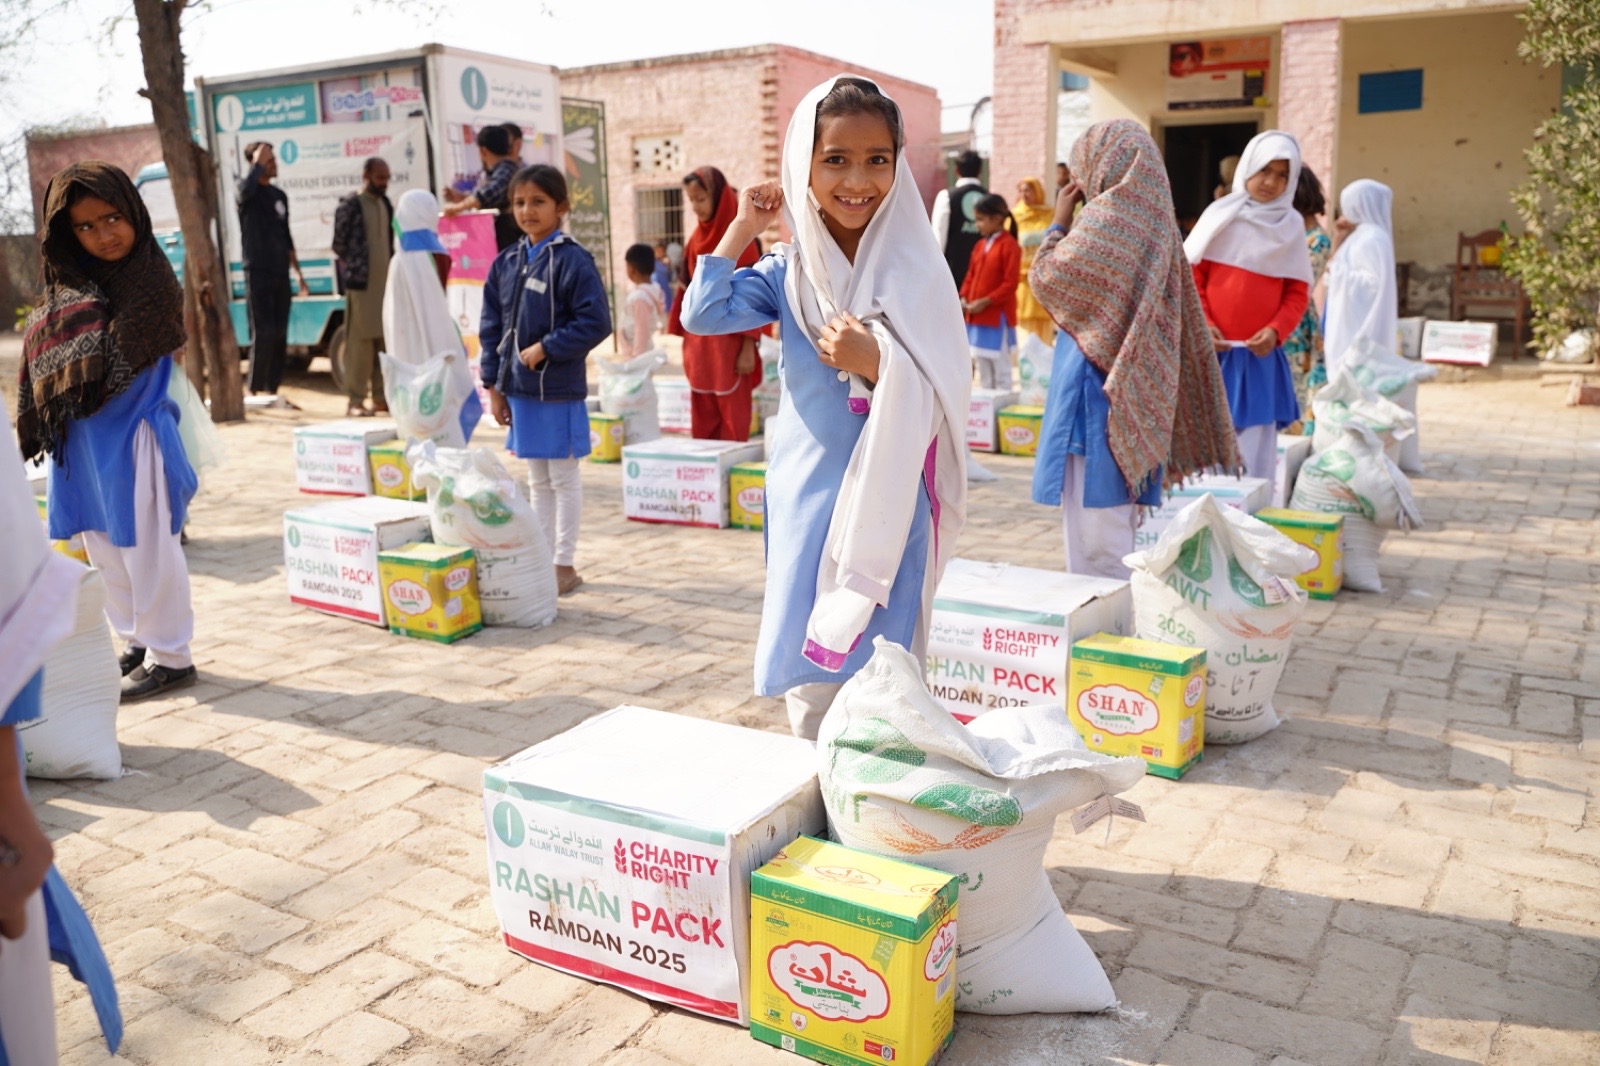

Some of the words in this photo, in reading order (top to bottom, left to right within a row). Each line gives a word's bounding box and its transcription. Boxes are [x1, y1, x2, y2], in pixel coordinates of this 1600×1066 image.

[626, 485, 678, 500] RASHAN
[681, 489, 717, 503] PACK
[741, 491, 763, 503] SHA
[639, 502, 679, 514] RAMDAN
[340, 536, 371, 550] CHARITY
[288, 557, 339, 579] RASHAN
[341, 566, 375, 586] PACK
[302, 579, 340, 597] RAMDAN
[341, 587, 364, 602] 2025
[392, 586, 425, 602] SHAN
[1165, 572, 1212, 611] AWT
[995, 628, 1059, 648] CHARITY
[1157, 613, 1196, 646] 2025
[995, 641, 1038, 658] RIGHT
[926, 655, 985, 683] SHAN
[993, 667, 1057, 696] PACK
[926, 683, 983, 706] MDAN
[1087, 692, 1146, 717] SHAN
[529, 838, 552, 852] ALLAH
[553, 845, 579, 859] WALAY
[580, 852, 604, 867] TRUST
[629, 841, 719, 876] CHARITY
[631, 861, 691, 890] RIGHT
[495, 860, 621, 923] RASHAN
[631, 900, 725, 949] PACK
[528, 909, 623, 955] RAMDAN
[628, 940, 687, 974] 2025
[789, 952, 867, 998] شان
